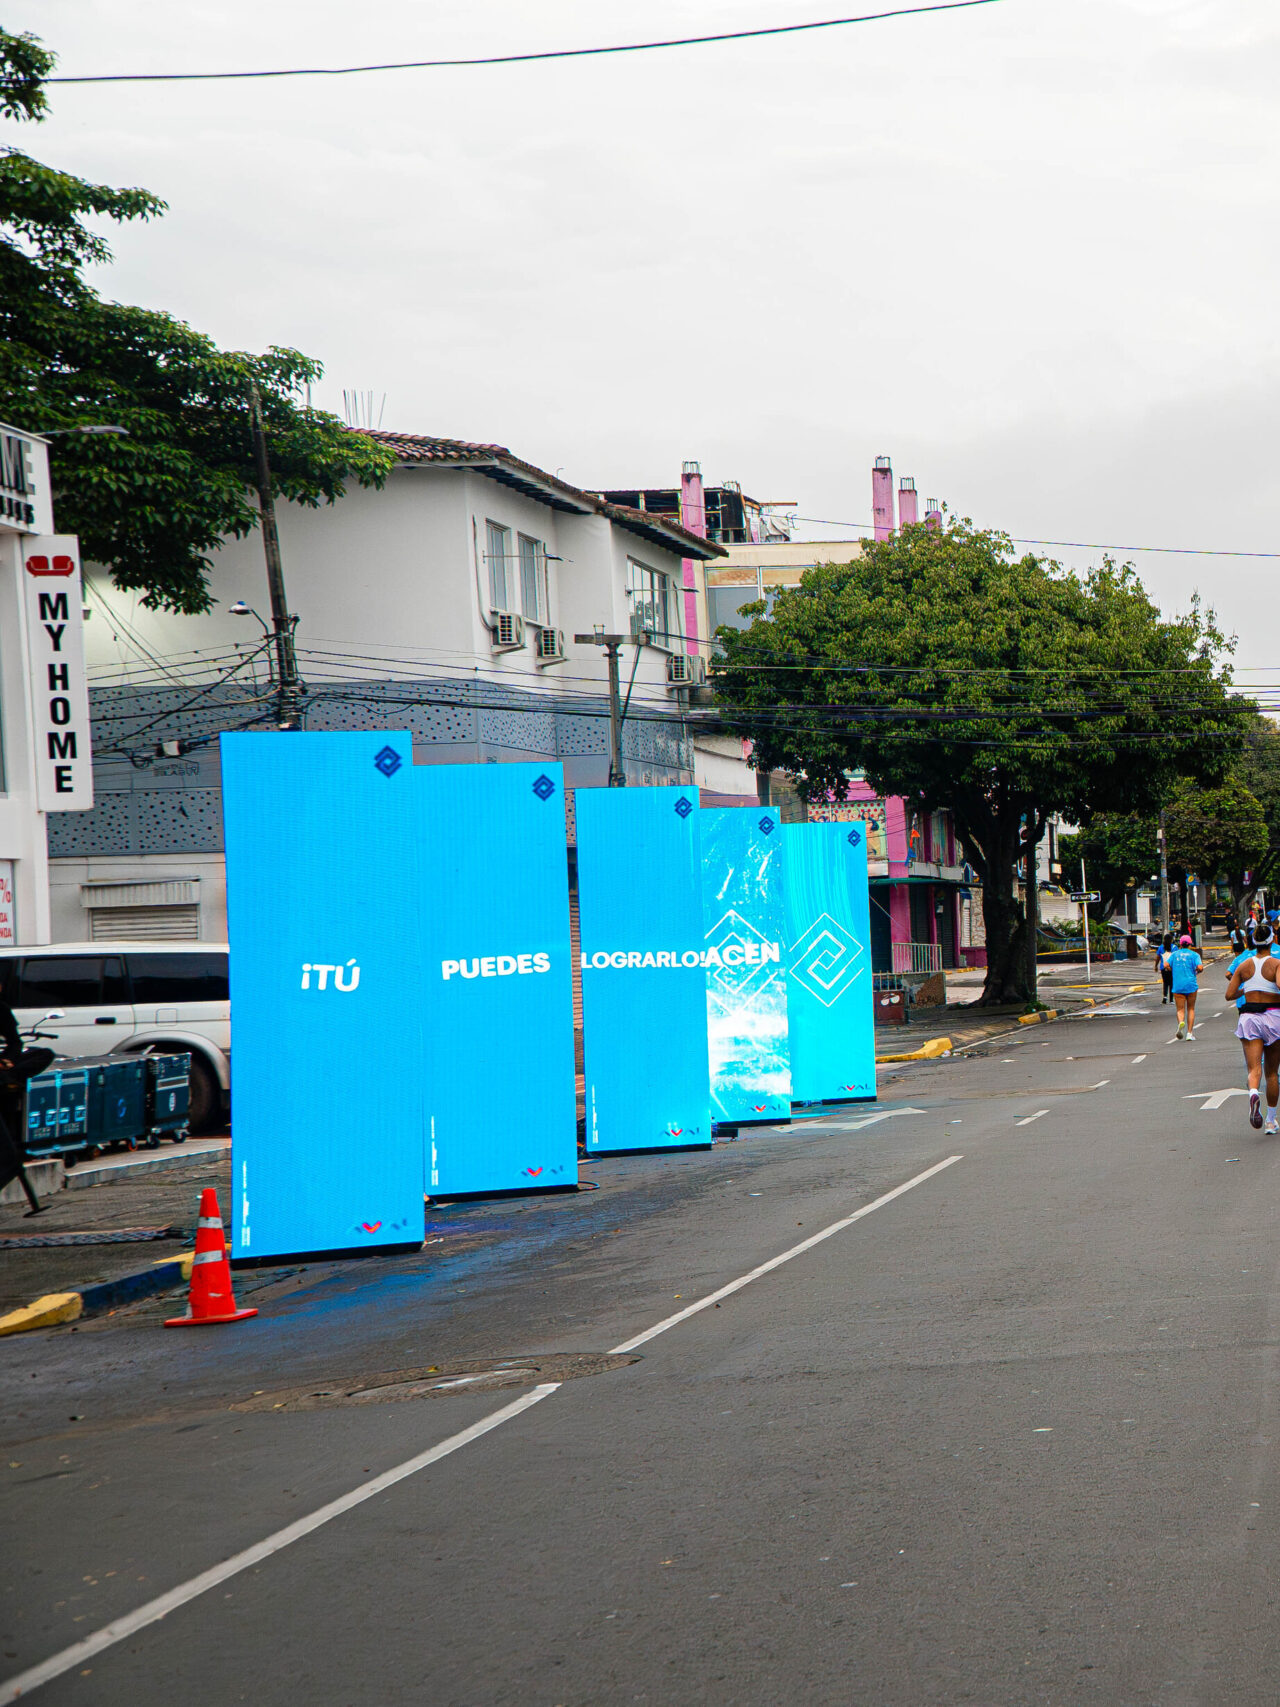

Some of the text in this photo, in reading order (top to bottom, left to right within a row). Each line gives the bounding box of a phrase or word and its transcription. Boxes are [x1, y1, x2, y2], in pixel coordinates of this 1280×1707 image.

[38, 592, 78, 793] MY HOME
[442, 952, 551, 980] PUEDES
[581, 951, 706, 969] LOGRARLO!
[704, 942, 780, 967] ACEN
